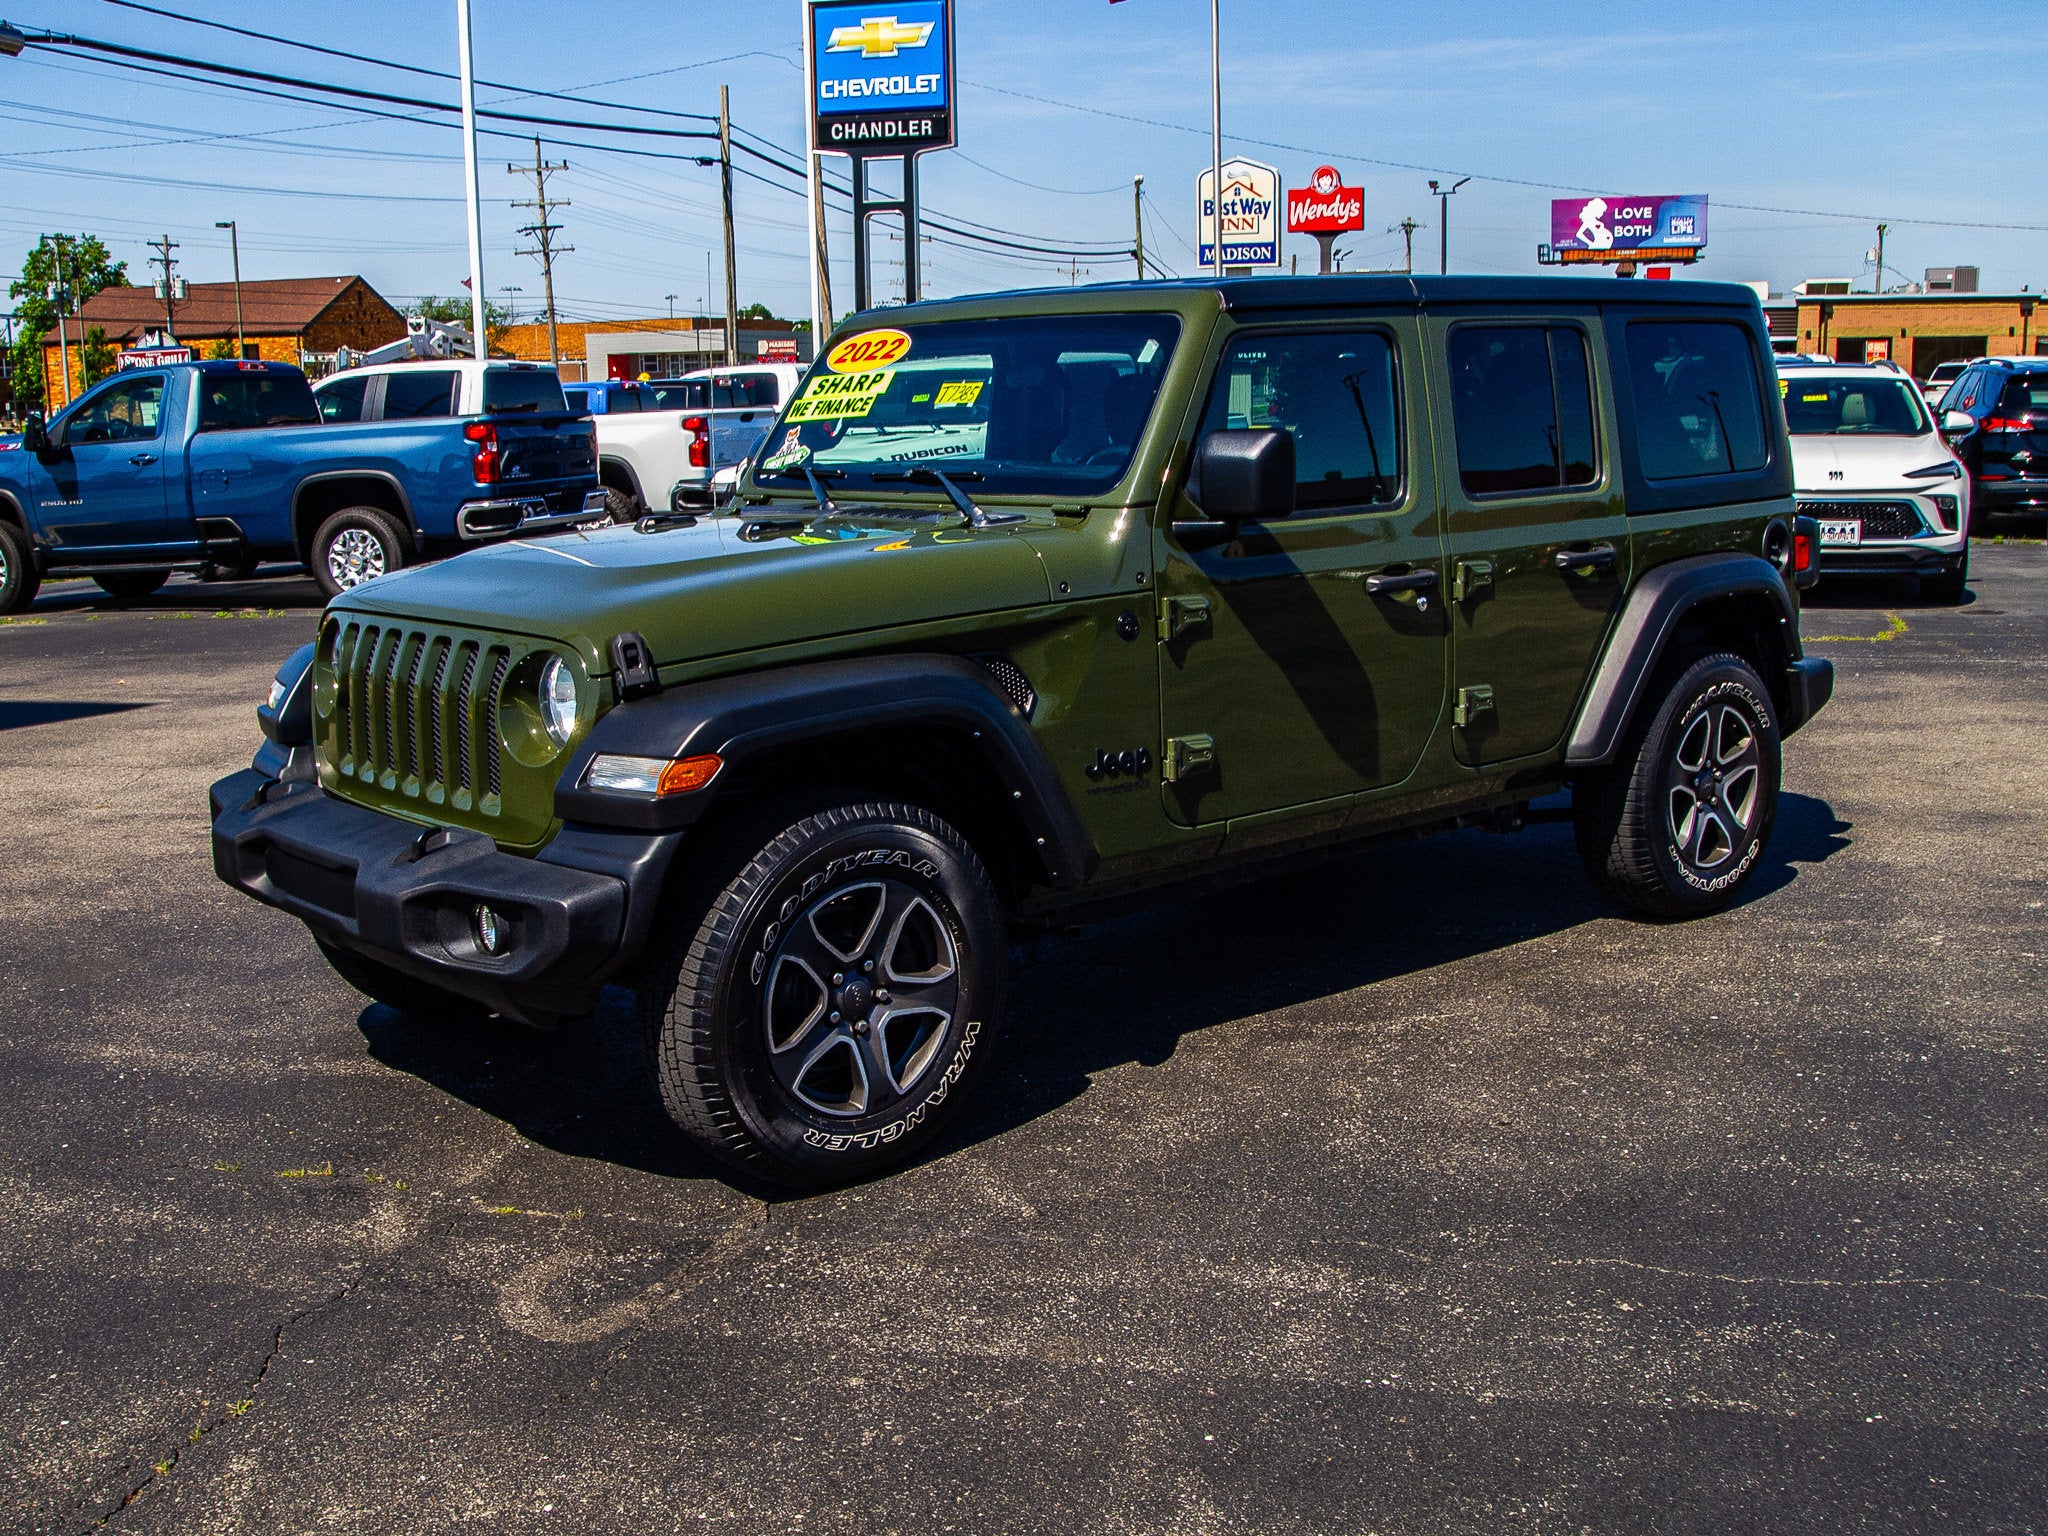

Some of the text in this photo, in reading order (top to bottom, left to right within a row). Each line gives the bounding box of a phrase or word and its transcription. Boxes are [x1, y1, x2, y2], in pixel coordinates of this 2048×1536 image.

[820, 73, 941, 99] CHEVROLET
[831, 119, 933, 140] CHANDLER
[1203, 198, 1272, 220] Bst Way
[1290, 194, 1360, 226] Wendy's
[1614, 206, 1653, 220] LOVE
[1614, 225, 1652, 237] BOTH
[833, 338, 906, 364] 2022
[812, 373, 886, 395] SHARP
[789, 396, 873, 417] WE FINANCE
[890, 444, 969, 462] RUBICON
[1084, 747, 1153, 783] Jeep
[750, 849, 940, 985] GOODYEAR
[803, 1021, 982, 1152] WRANGLER
